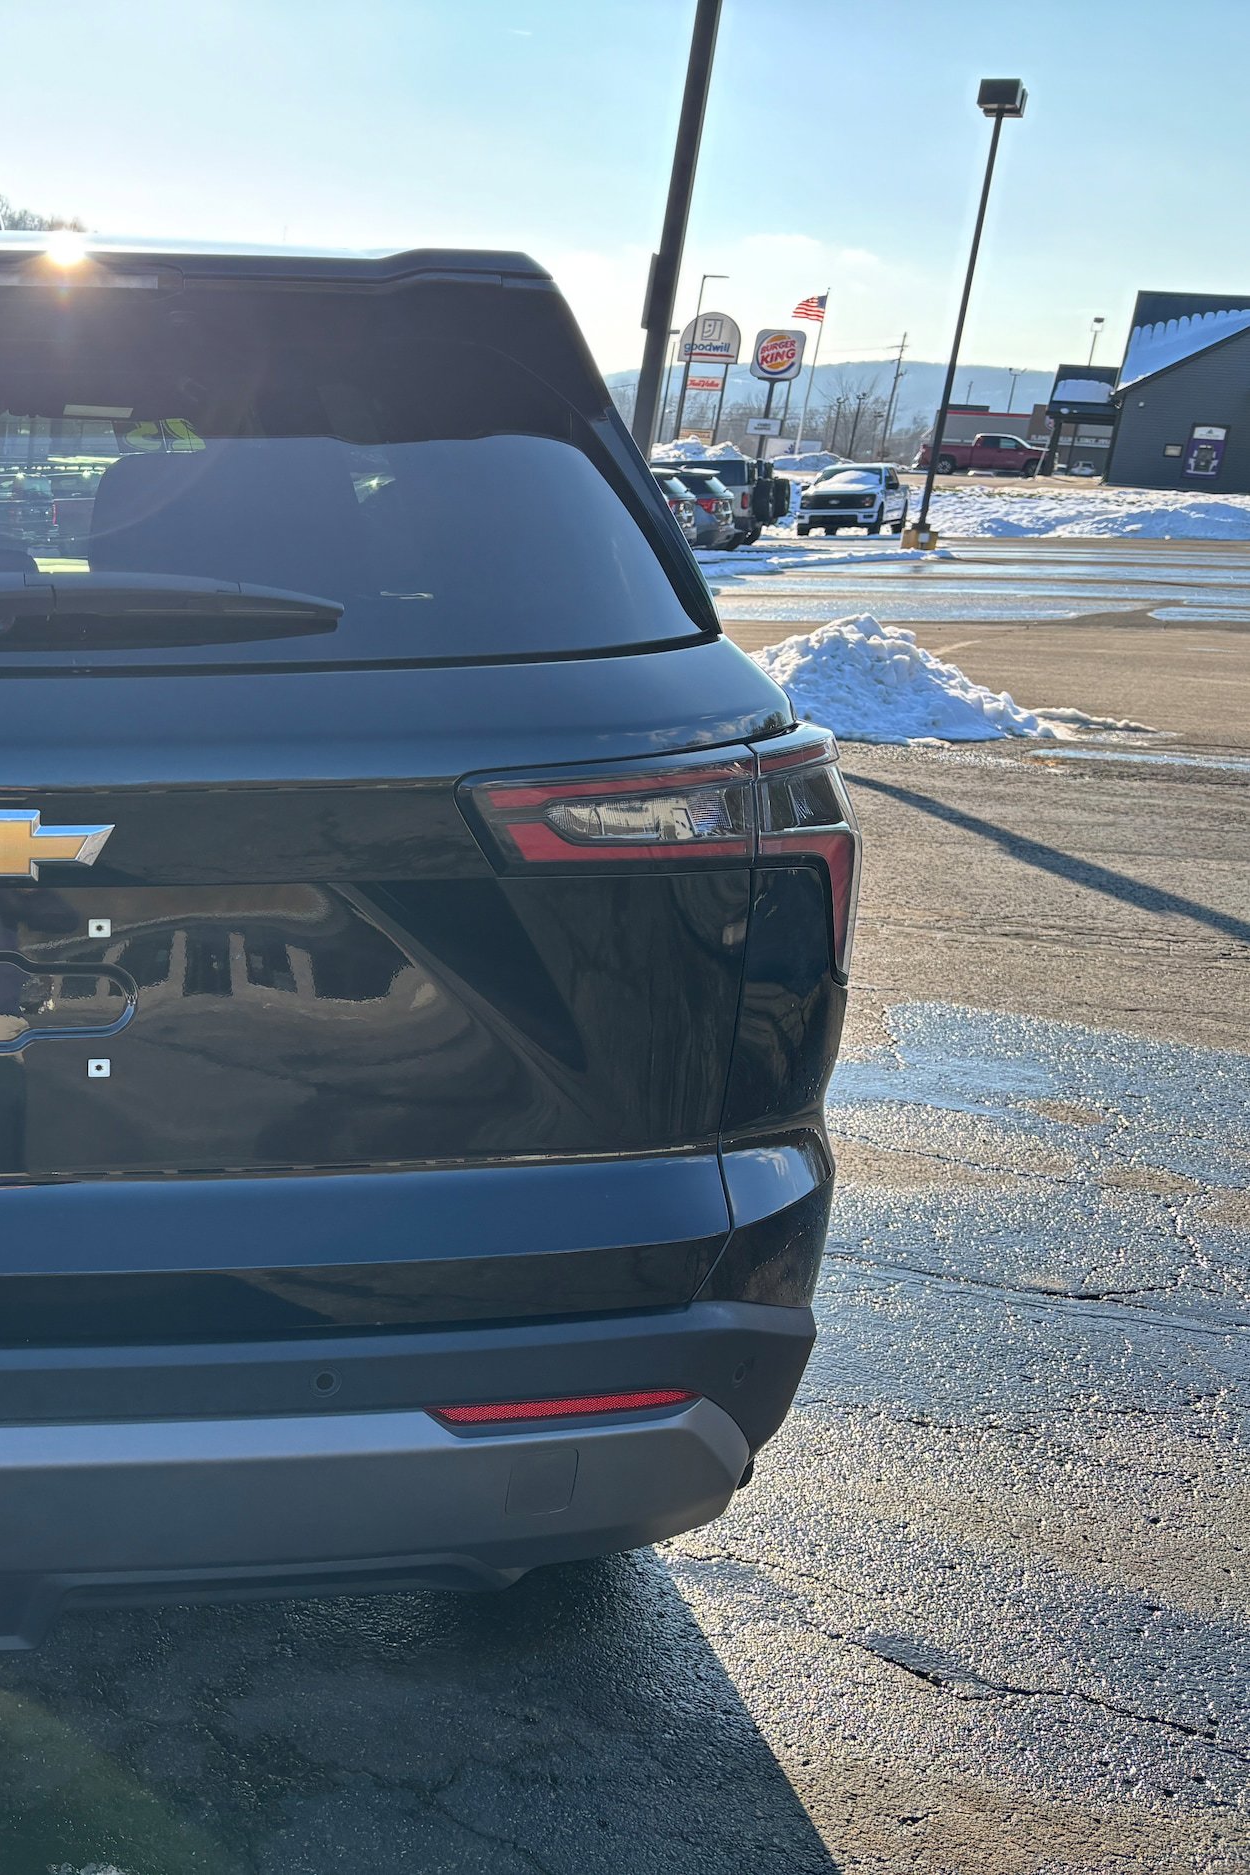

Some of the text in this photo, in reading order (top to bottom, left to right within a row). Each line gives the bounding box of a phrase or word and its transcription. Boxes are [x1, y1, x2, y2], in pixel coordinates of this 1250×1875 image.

[684, 342, 731, 353] goodwill
[760, 340, 796, 354] BURGER
[760, 348, 796, 366] KING
